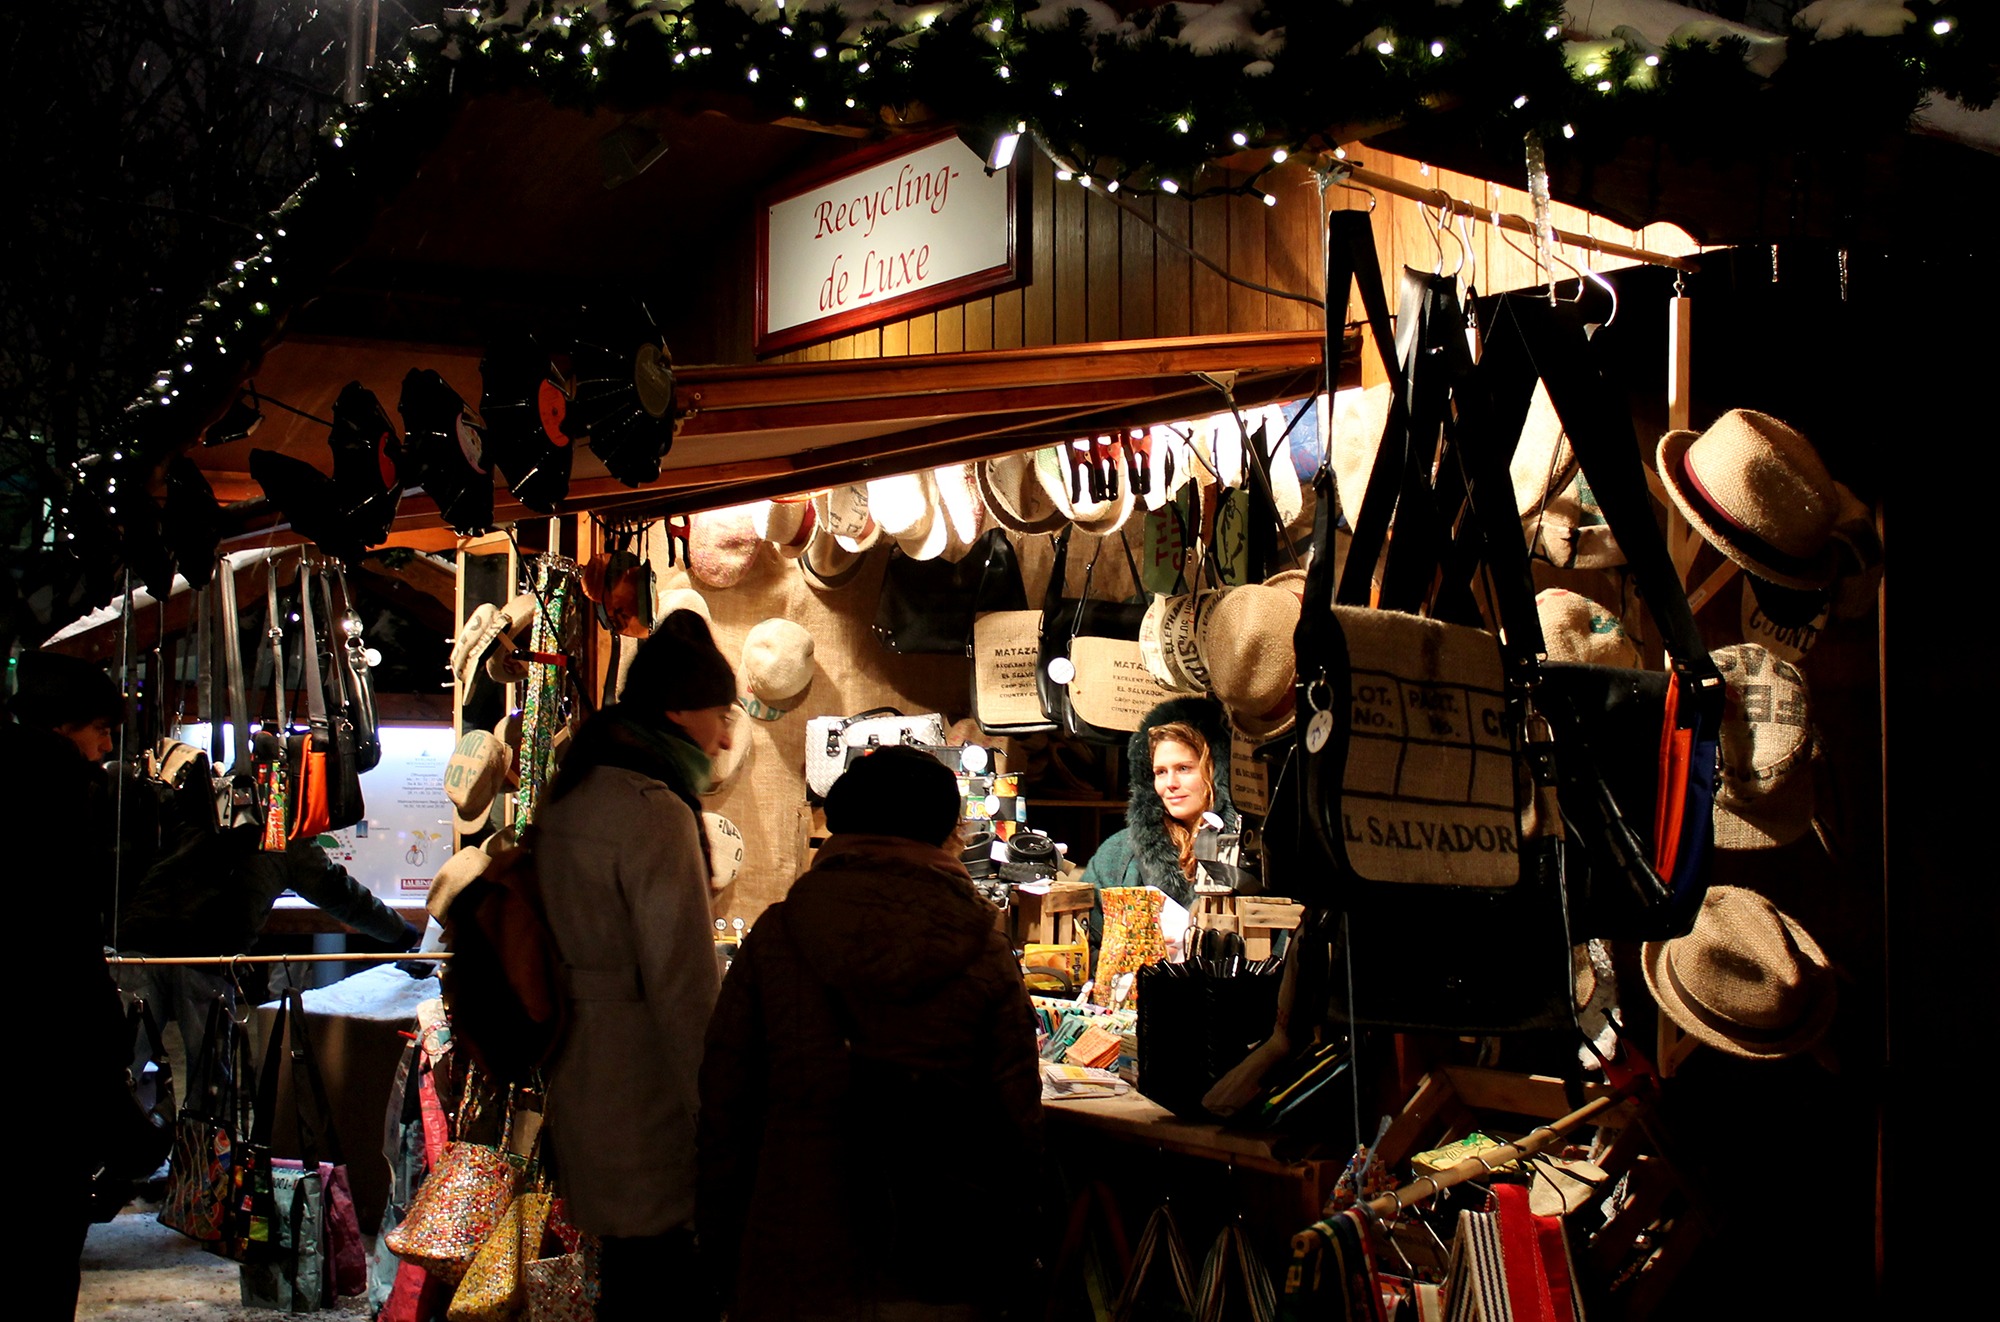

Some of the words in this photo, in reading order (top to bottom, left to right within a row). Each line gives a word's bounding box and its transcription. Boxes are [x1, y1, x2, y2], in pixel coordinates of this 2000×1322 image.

[813, 163, 960, 240] Recycling-
[818, 253, 849, 312] de
[857, 243, 931, 300] Luxe
[1352, 686, 1391, 707] OT.
[1367, 815, 1519, 853] SALVADOR
